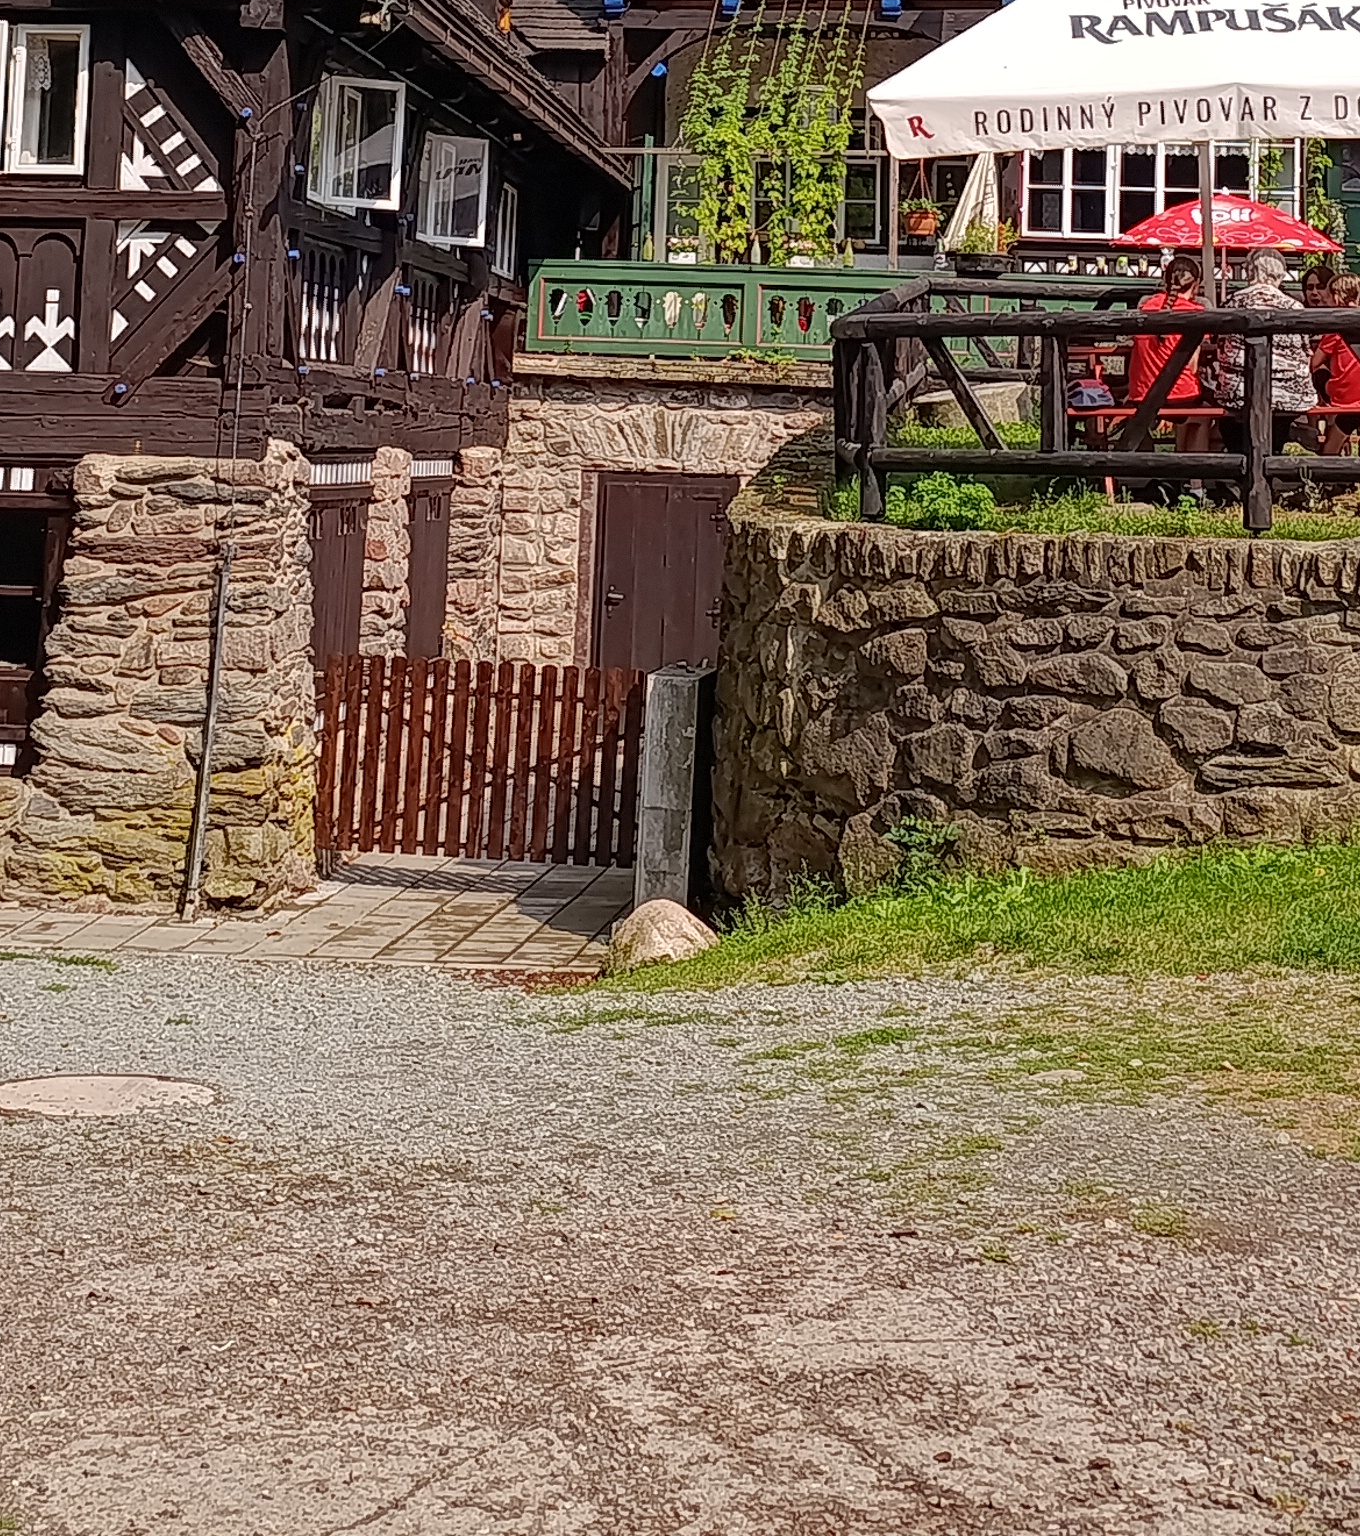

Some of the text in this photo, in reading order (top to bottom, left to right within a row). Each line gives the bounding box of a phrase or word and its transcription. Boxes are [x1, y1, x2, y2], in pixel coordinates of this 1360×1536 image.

[906, 115, 936, 140] R
[973, 95, 1116, 137] RODINNÝ
[1137, 95, 1278, 127] PIVOVAR
[1299, 95, 1313, 121] Z
